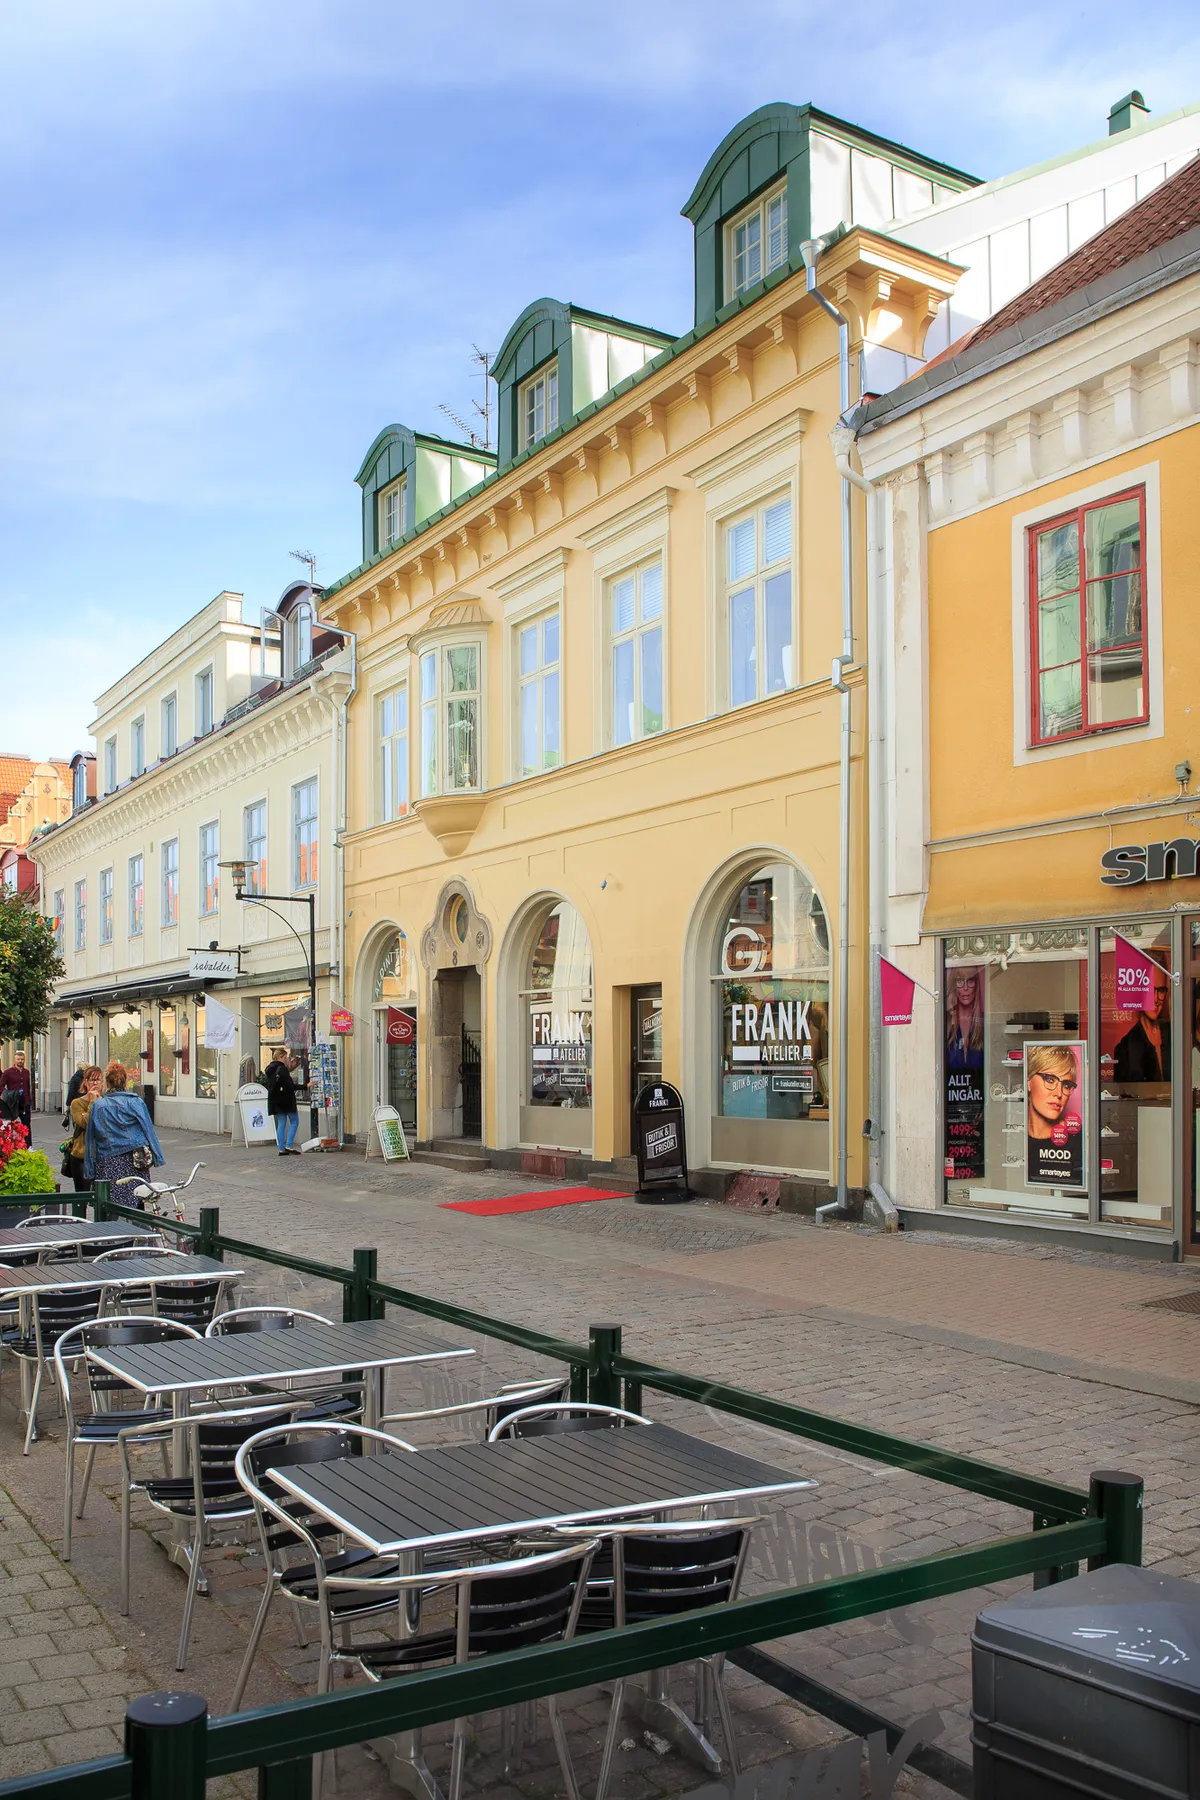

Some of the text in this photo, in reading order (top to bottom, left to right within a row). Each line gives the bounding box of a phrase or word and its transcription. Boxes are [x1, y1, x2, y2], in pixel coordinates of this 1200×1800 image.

[452, 949, 458, 966] 8
[1117, 968, 1150, 986] 50%
[532, 1012, 586, 1045] FRANK
[732, 1001, 812, 1041] FRANK
[560, 1048, 586, 1061] ATELIER
[761, 1045, 800, 1061] ATELIER
[948, 1074, 971, 1086] ALLT
[948, 1086, 983, 1102] INGÅR.
[649, 1100, 665, 1108] FRANK
[648, 1127, 669, 1144] BUTIK &
[655, 1139, 675, 1155] FRISÖR
[1040, 1148, 1071, 1160] MOOD
[1039, 1169, 1071, 1177] smarteyes
